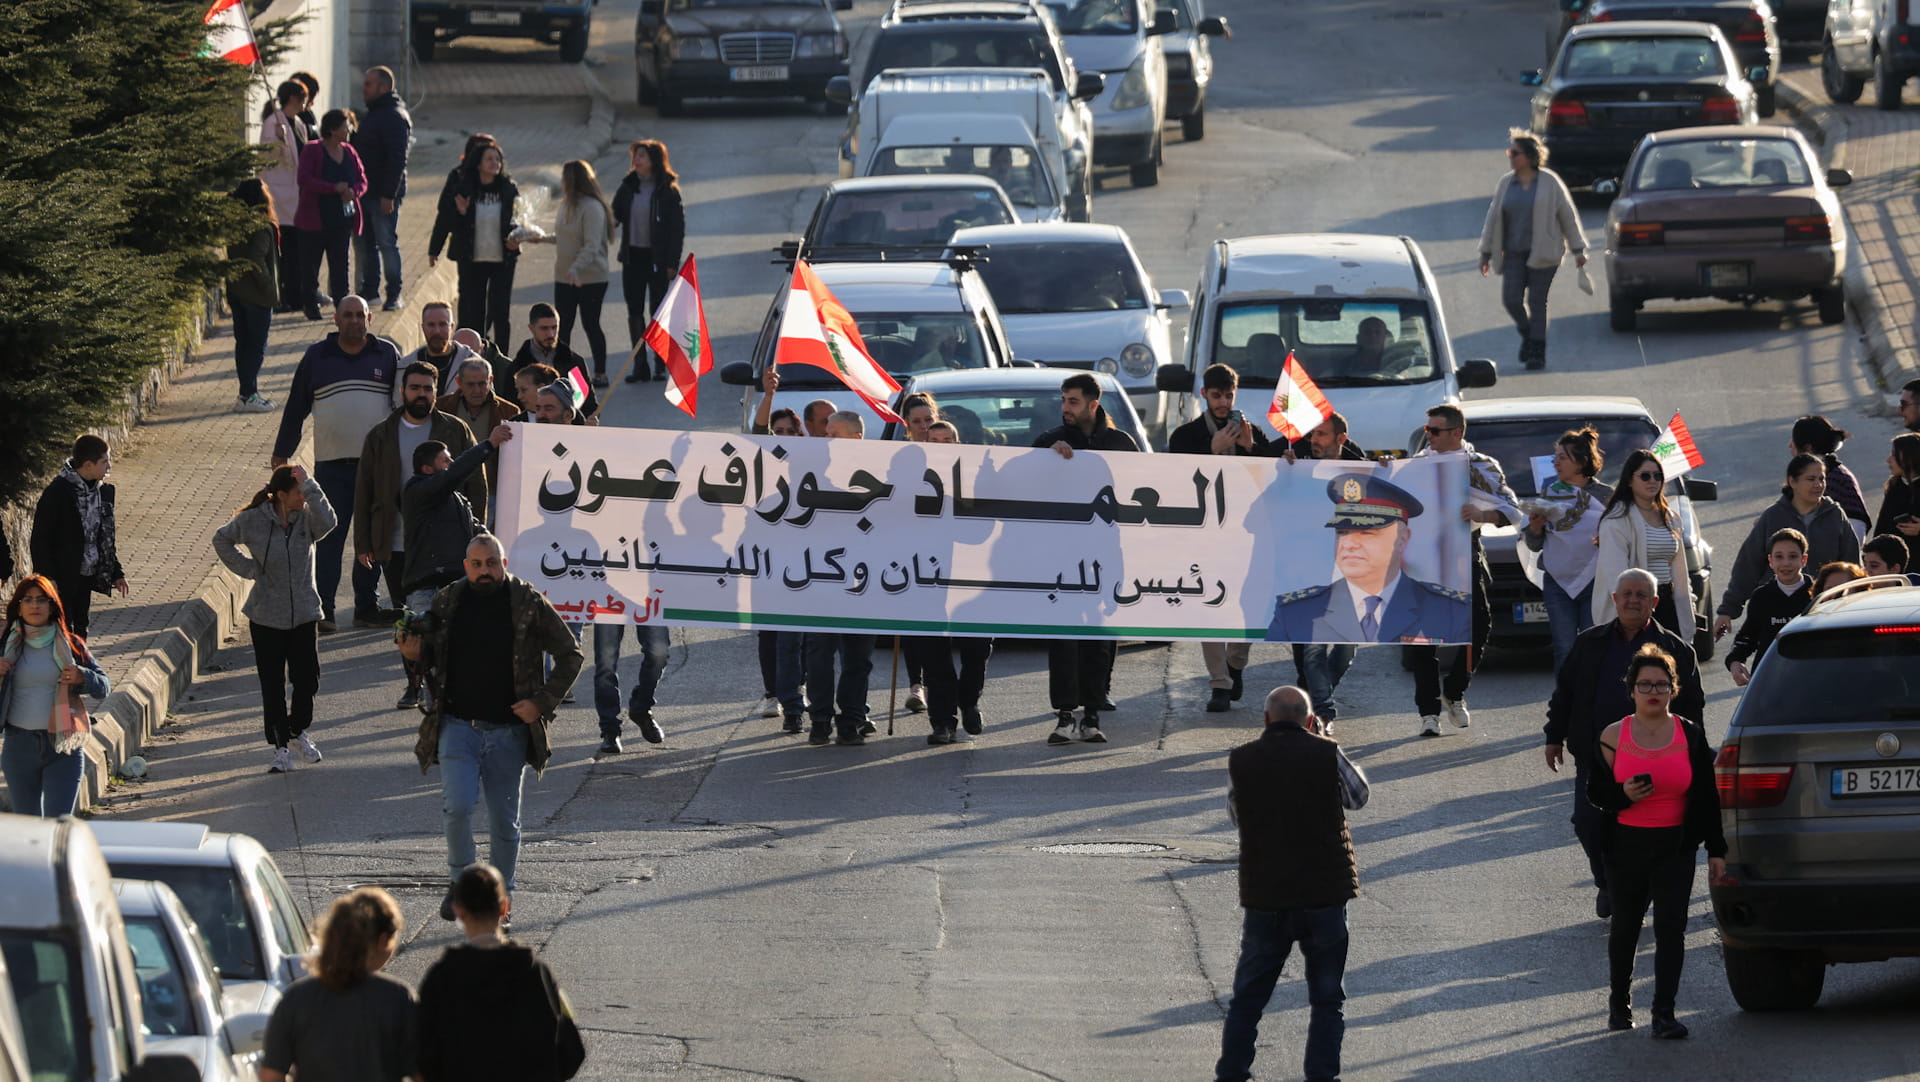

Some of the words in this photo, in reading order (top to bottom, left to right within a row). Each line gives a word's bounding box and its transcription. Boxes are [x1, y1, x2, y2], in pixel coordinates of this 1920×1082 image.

[538, 441, 681, 513] عون
[698, 441, 894, 532] جوزاف
[914, 457, 1227, 527] العماد
[540, 536, 771, 586] اللبنانيين
[782, 547, 869, 594] وكل
[881, 553, 1101, 601] للبنان
[1113, 563, 1226, 606] رئيس
[633, 588, 664, 623] آل
[1848, 771, 1858, 791] B
